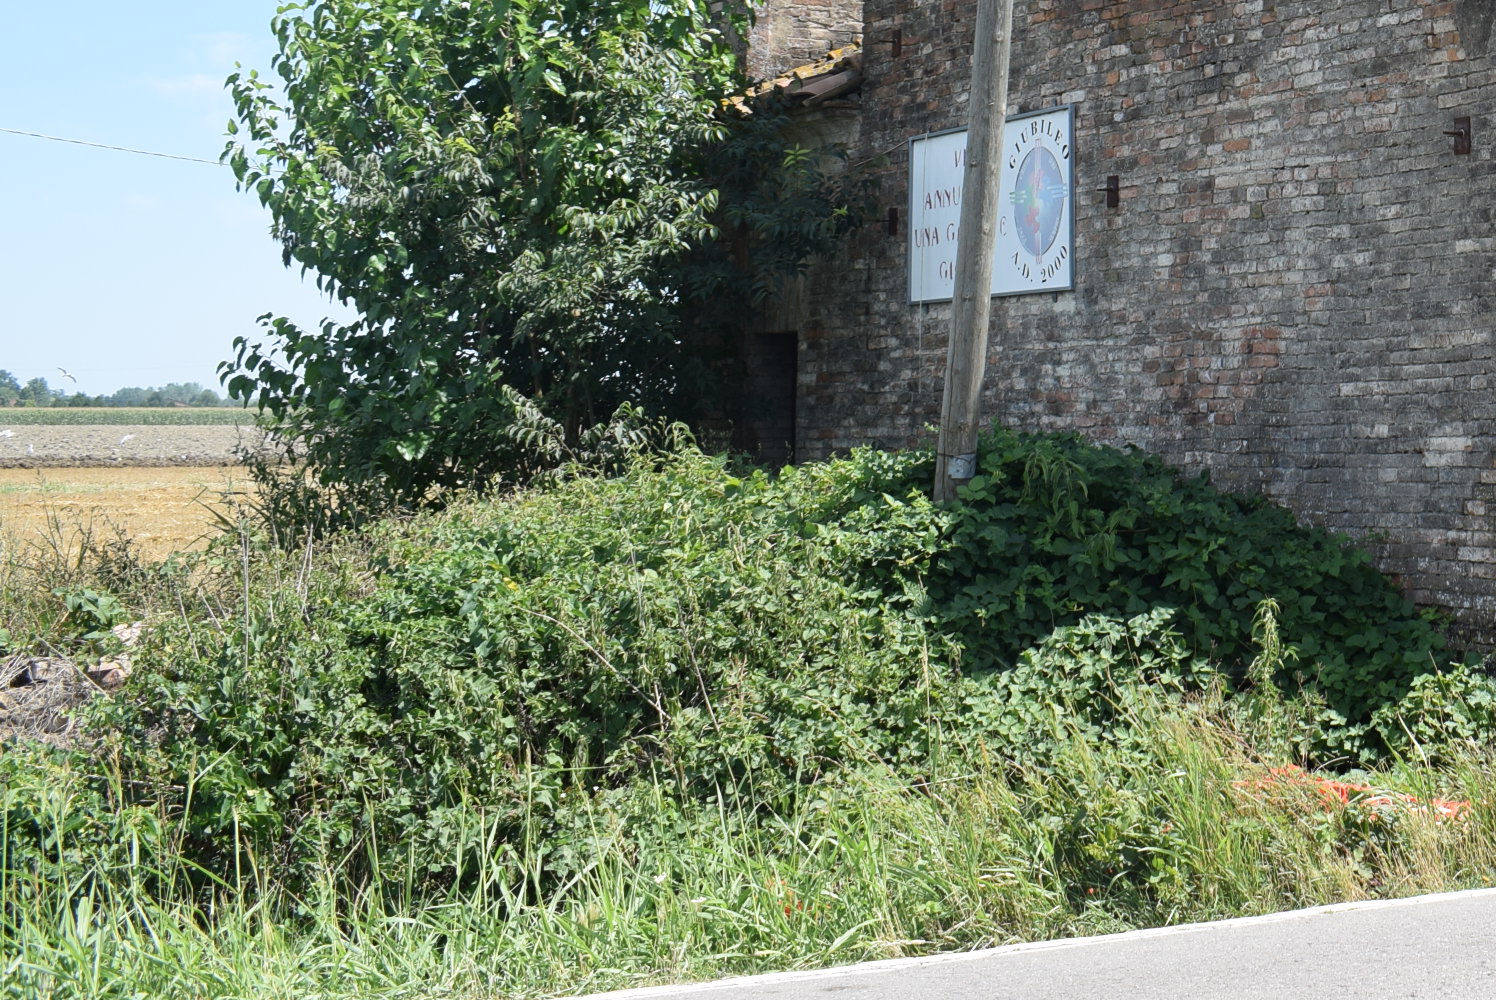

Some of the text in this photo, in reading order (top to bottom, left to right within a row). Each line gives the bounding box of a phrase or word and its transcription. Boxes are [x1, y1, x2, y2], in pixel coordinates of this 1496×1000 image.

[1009, 119, 1070, 170] GIUBILEO
[924, 185, 962, 211] ANNU
[914, 225, 939, 248] UNA
[1010, 245, 1068, 284] A.D. 2000
